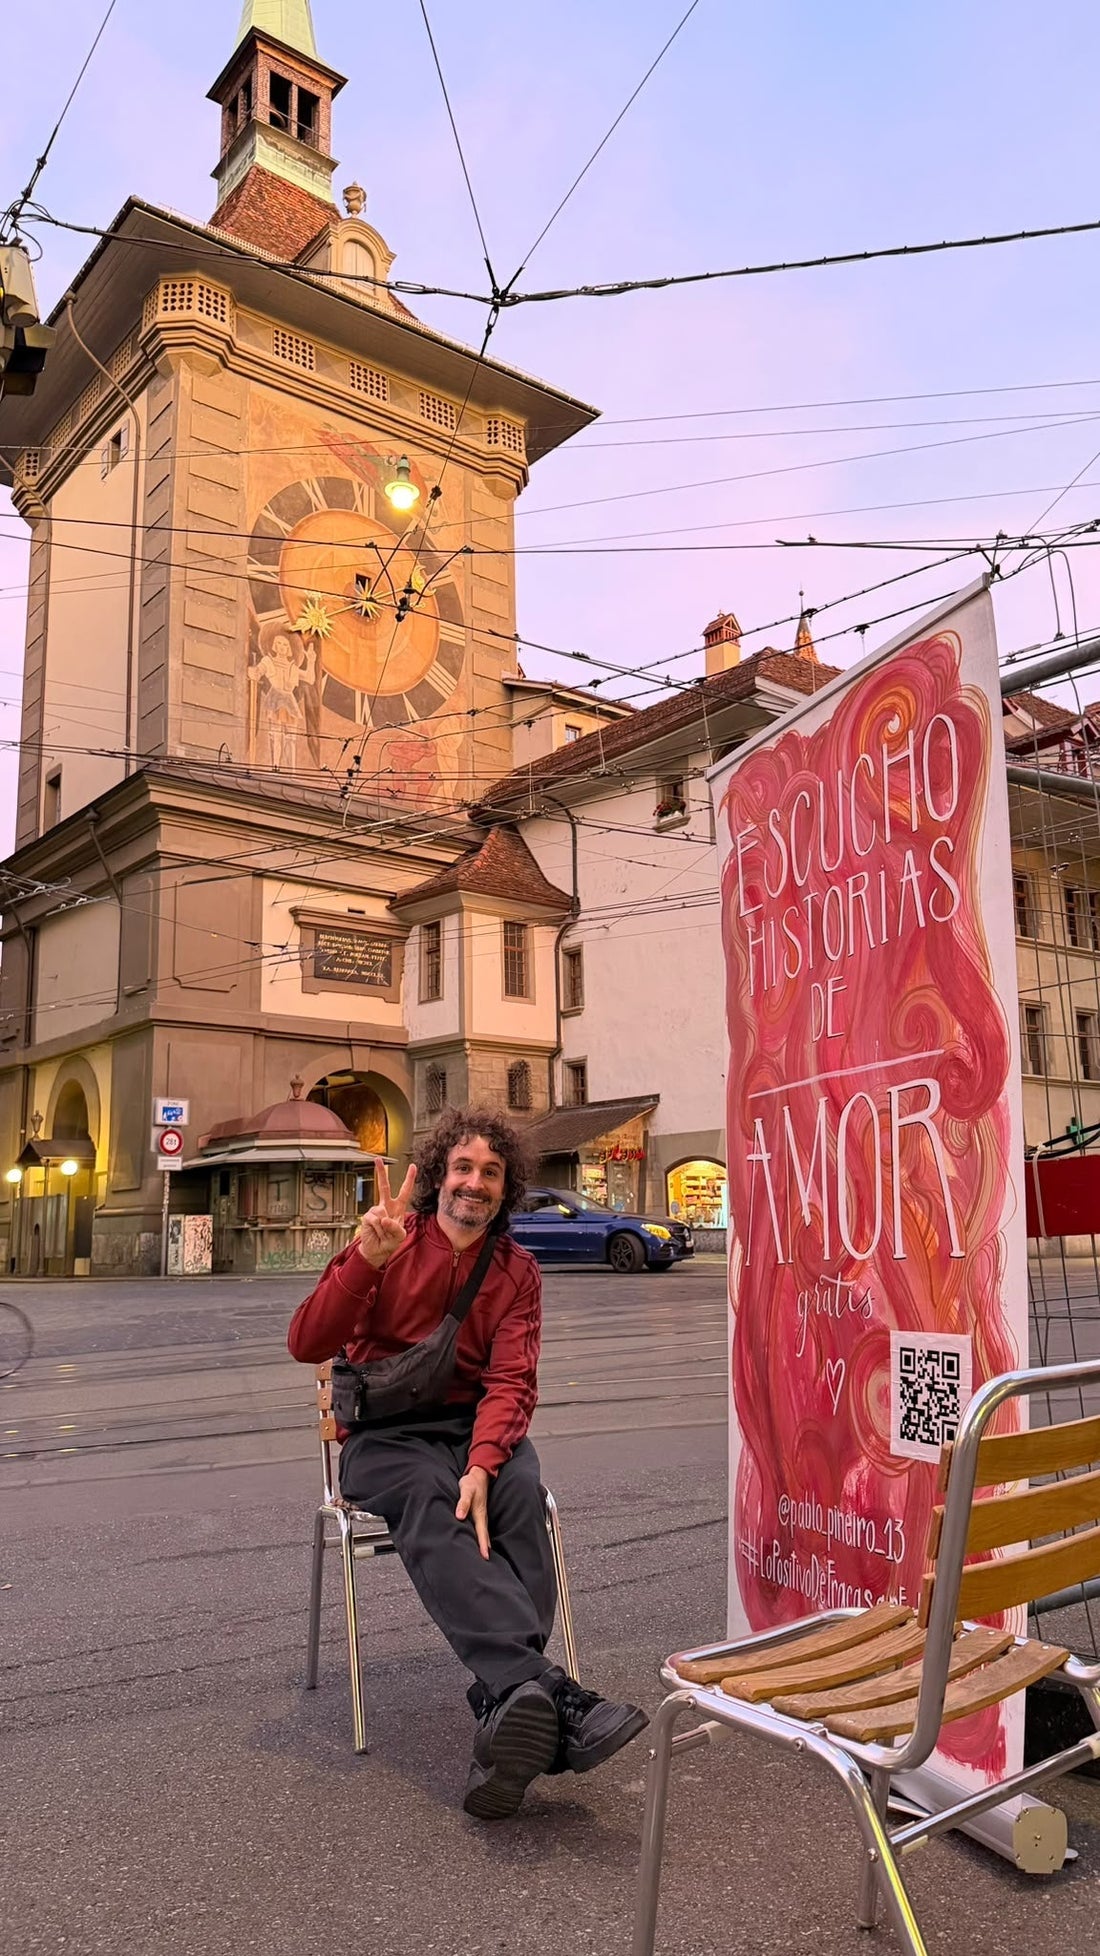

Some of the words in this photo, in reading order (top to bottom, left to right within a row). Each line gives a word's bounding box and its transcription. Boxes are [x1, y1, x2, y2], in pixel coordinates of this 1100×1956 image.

[736, 713, 959, 918] ESCUCHO
[811, 976, 847, 1042] DE
[746, 1078, 966, 1266] AMOR
[797, 1272, 875, 1358] gratis
